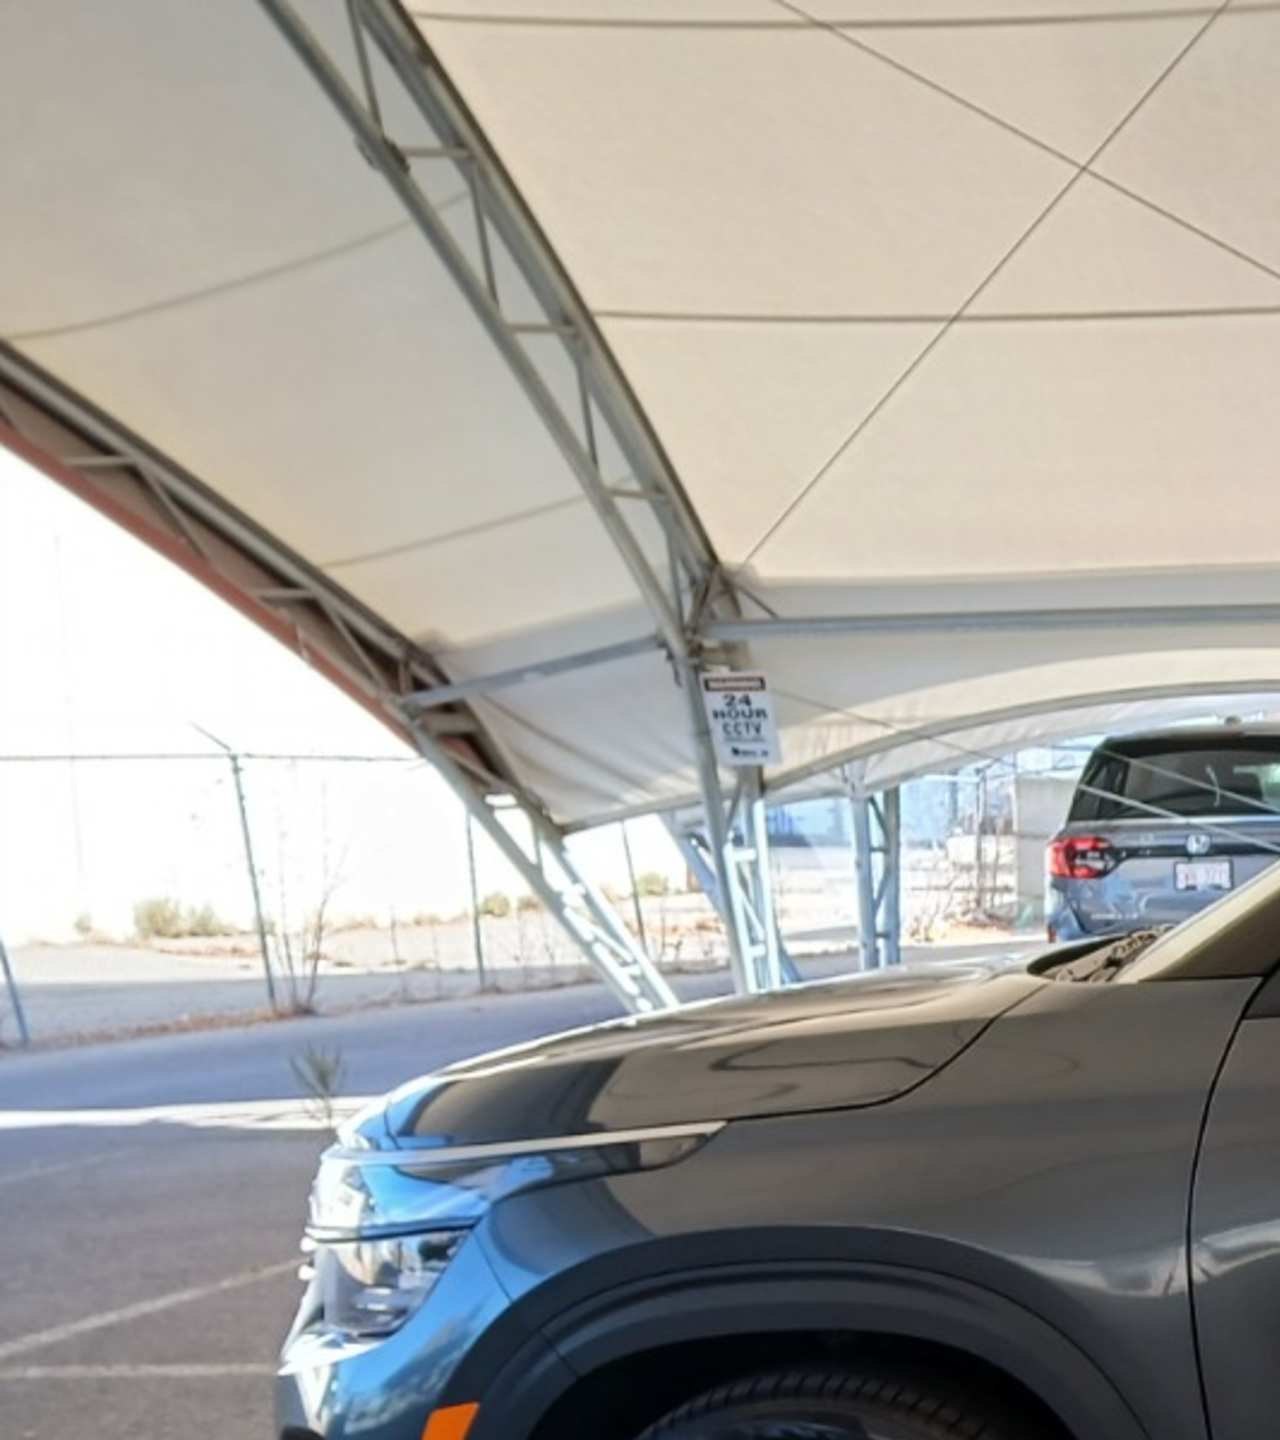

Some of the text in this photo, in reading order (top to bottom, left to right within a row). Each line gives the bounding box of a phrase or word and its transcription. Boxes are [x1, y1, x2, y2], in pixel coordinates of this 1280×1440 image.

[723, 693, 752, 707] 24
[712, 708, 768, 720] HOUR
[722, 722, 762, 735] CCTV
